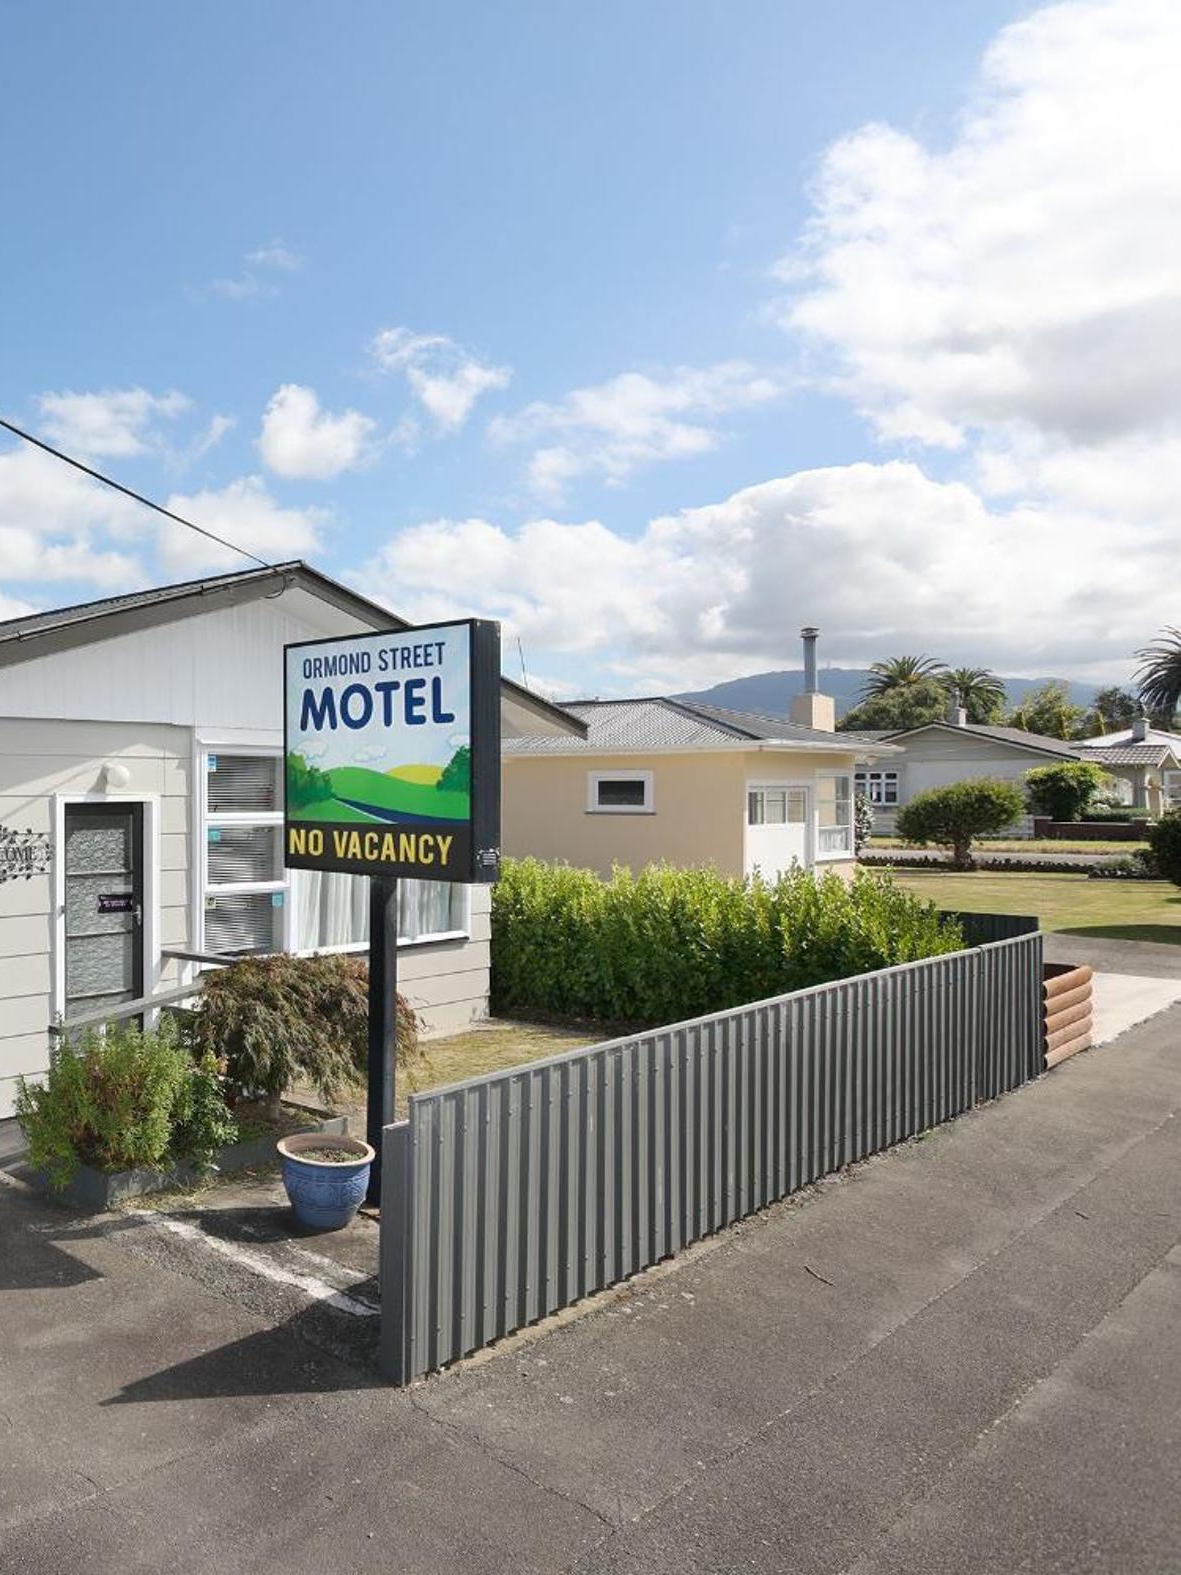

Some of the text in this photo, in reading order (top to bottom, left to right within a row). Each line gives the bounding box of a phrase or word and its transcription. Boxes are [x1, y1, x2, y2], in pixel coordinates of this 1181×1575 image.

[303, 642, 445, 679] ORMOND STREET
[300, 676, 455, 731] MOTEL
[289, 828, 323, 856] NO
[333, 830, 453, 866] VACANCY
